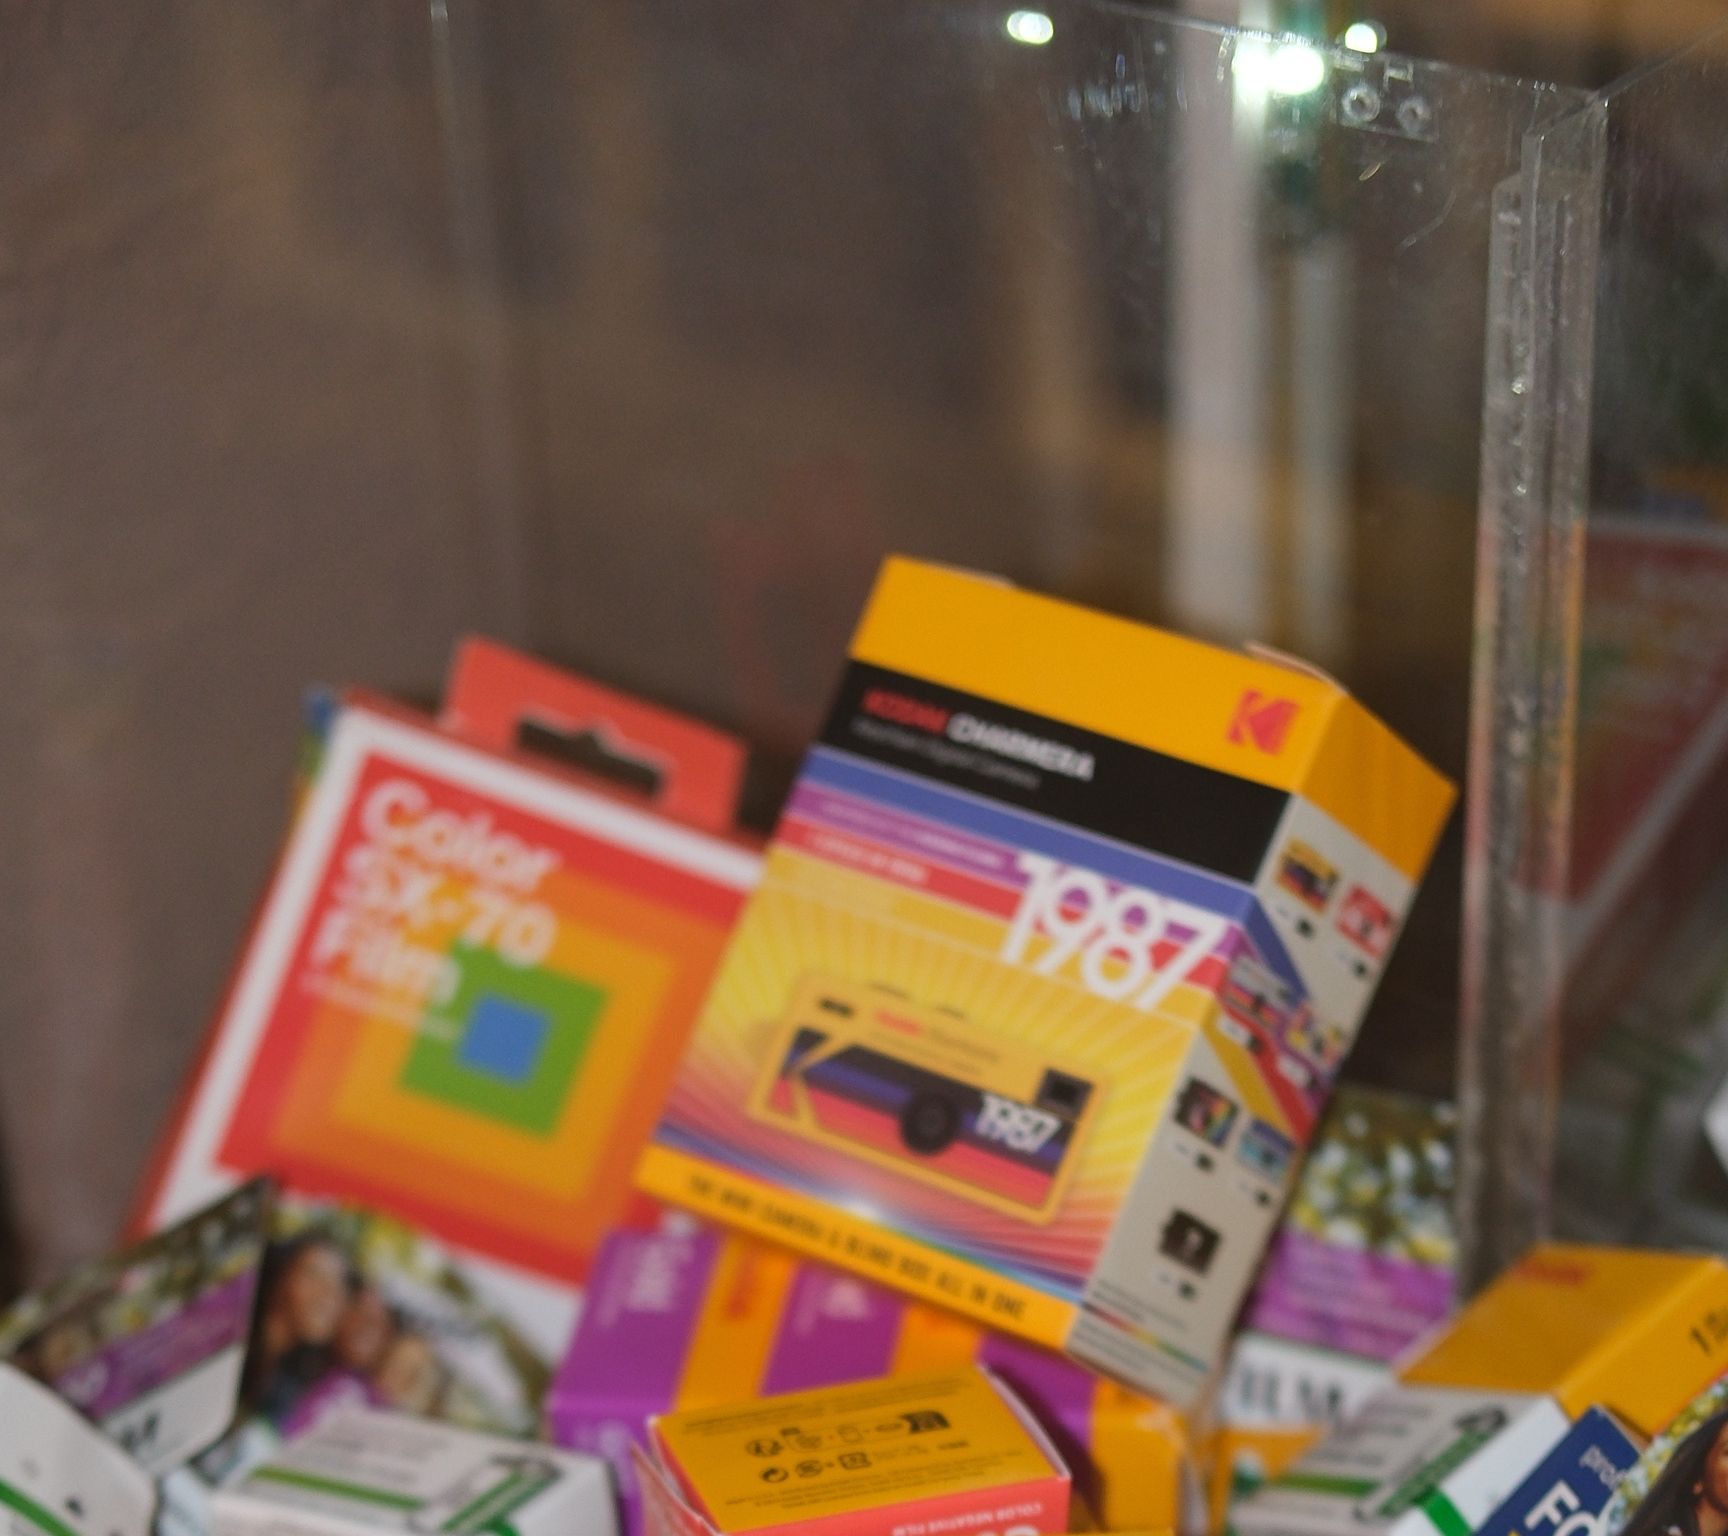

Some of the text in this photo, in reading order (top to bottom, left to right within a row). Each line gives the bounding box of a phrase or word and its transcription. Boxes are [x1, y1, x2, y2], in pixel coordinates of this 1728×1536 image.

[361, 779, 560, 890] Color
[305, 906, 462, 1009] Film
[335, 841, 558, 966] SX-70
[1000, 848, 1227, 1010] 1987
[976, 1092, 1060, 1153] 1987
